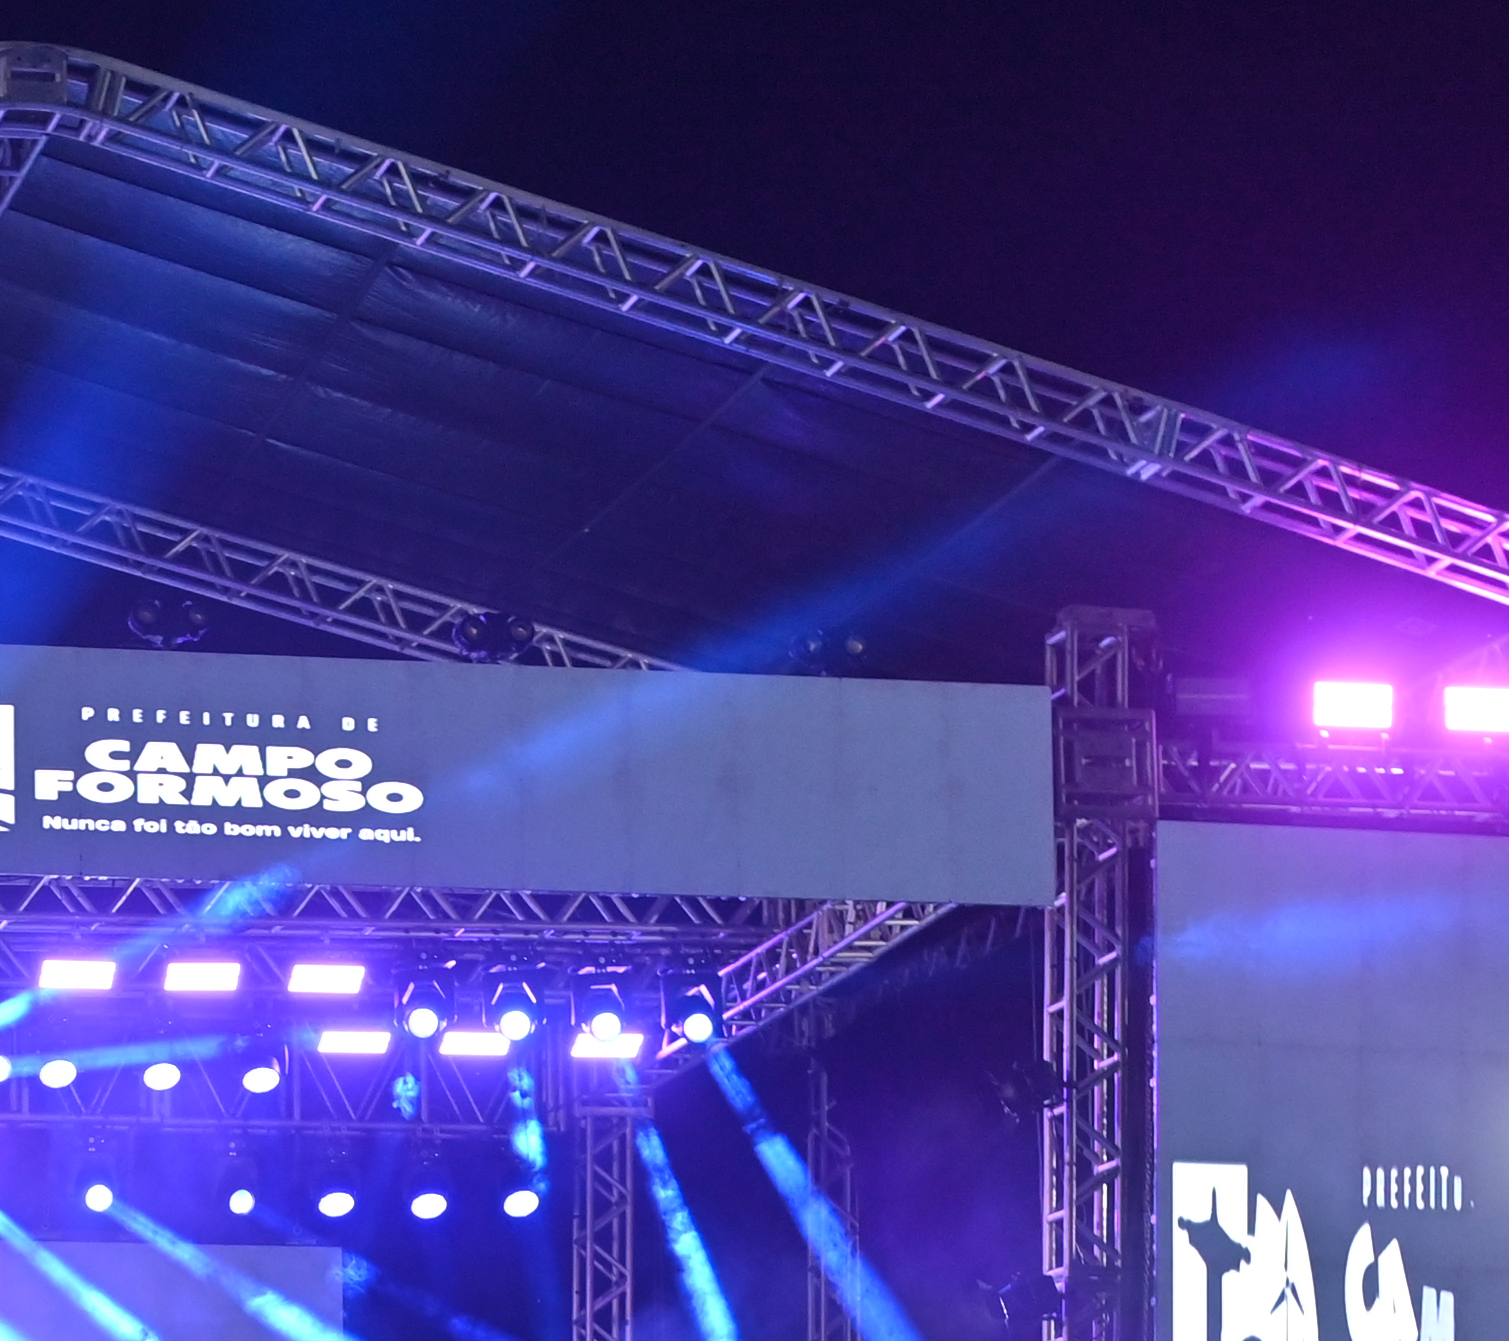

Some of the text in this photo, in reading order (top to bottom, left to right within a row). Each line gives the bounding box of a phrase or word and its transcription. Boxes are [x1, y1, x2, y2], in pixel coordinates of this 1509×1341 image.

[81, 706, 379, 733] PREFEITURA DE
[84, 738, 373, 780] CAMPO
[34, 768, 424, 815] FORMOSO
[42, 814, 422, 845] Nunca foi tão bom viver aqui.
